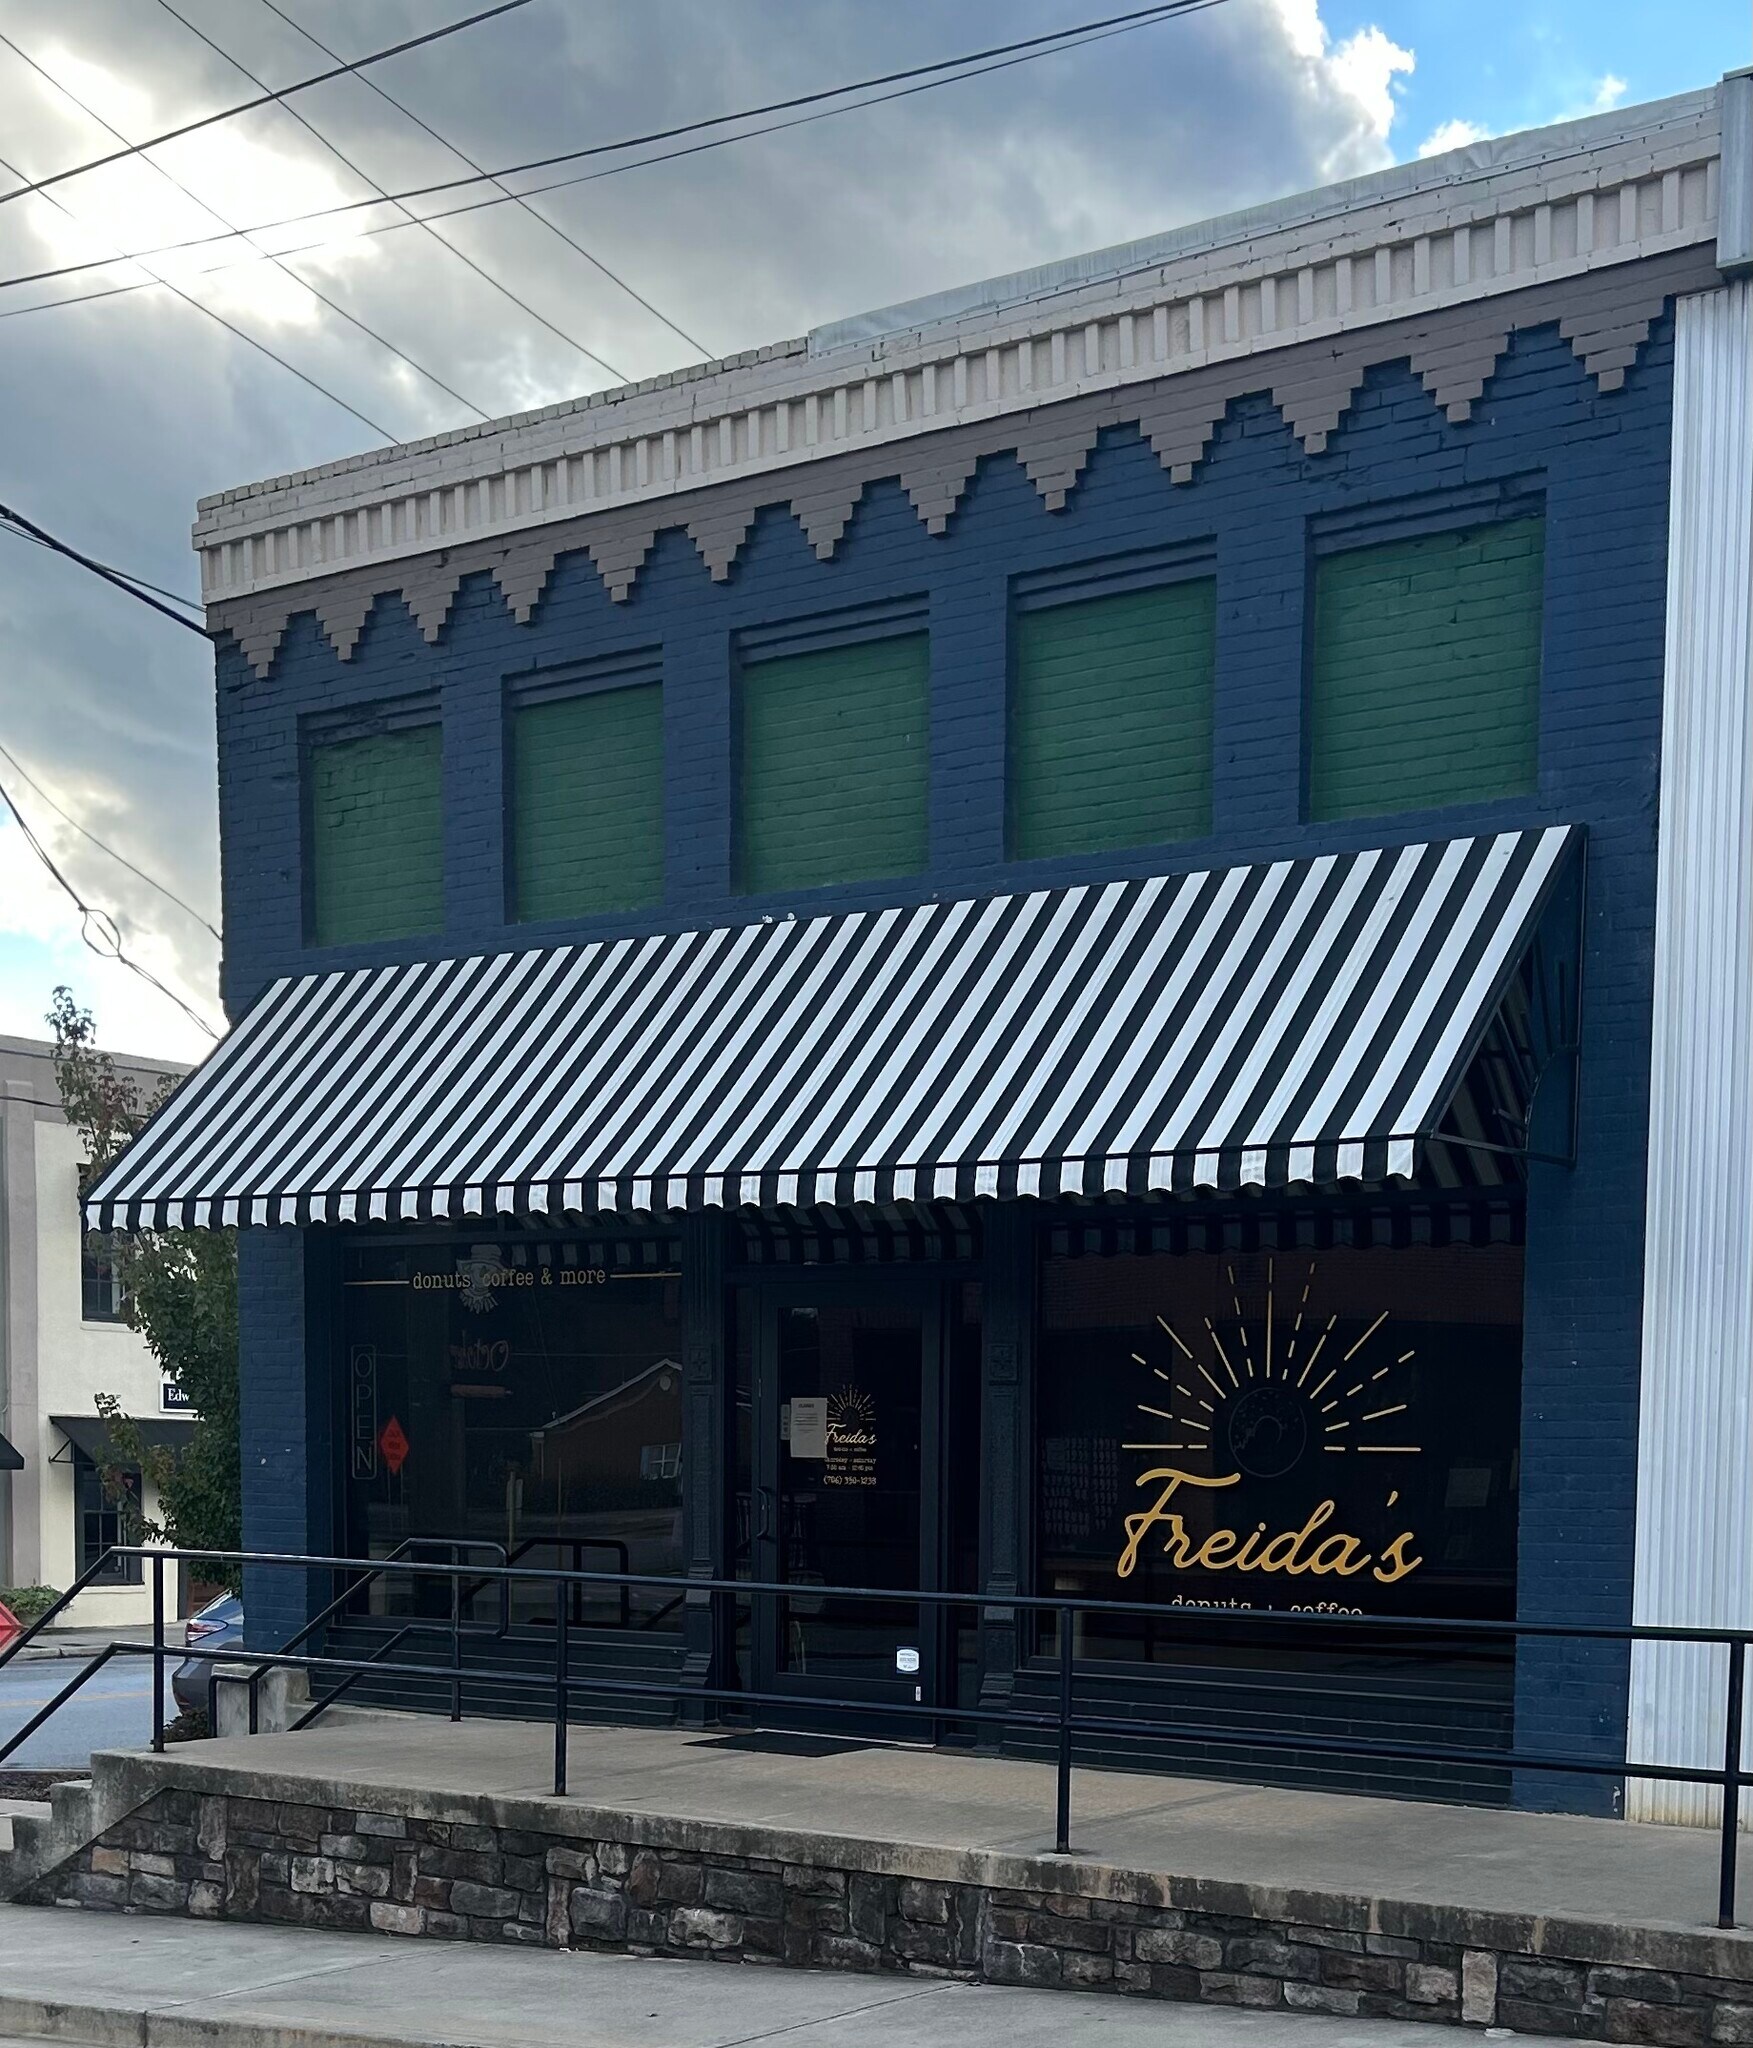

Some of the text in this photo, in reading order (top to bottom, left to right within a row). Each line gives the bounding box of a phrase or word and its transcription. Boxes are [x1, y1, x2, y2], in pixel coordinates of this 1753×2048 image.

[482, 1268, 534, 1287] coffee
[540, 1267, 553, 1286] &
[559, 1269, 606, 1285] more
[355, 1353, 372, 1471] OPEN
[825, 1424, 877, 1445] Freida's
[1117, 1467, 1423, 1583] Freida's
